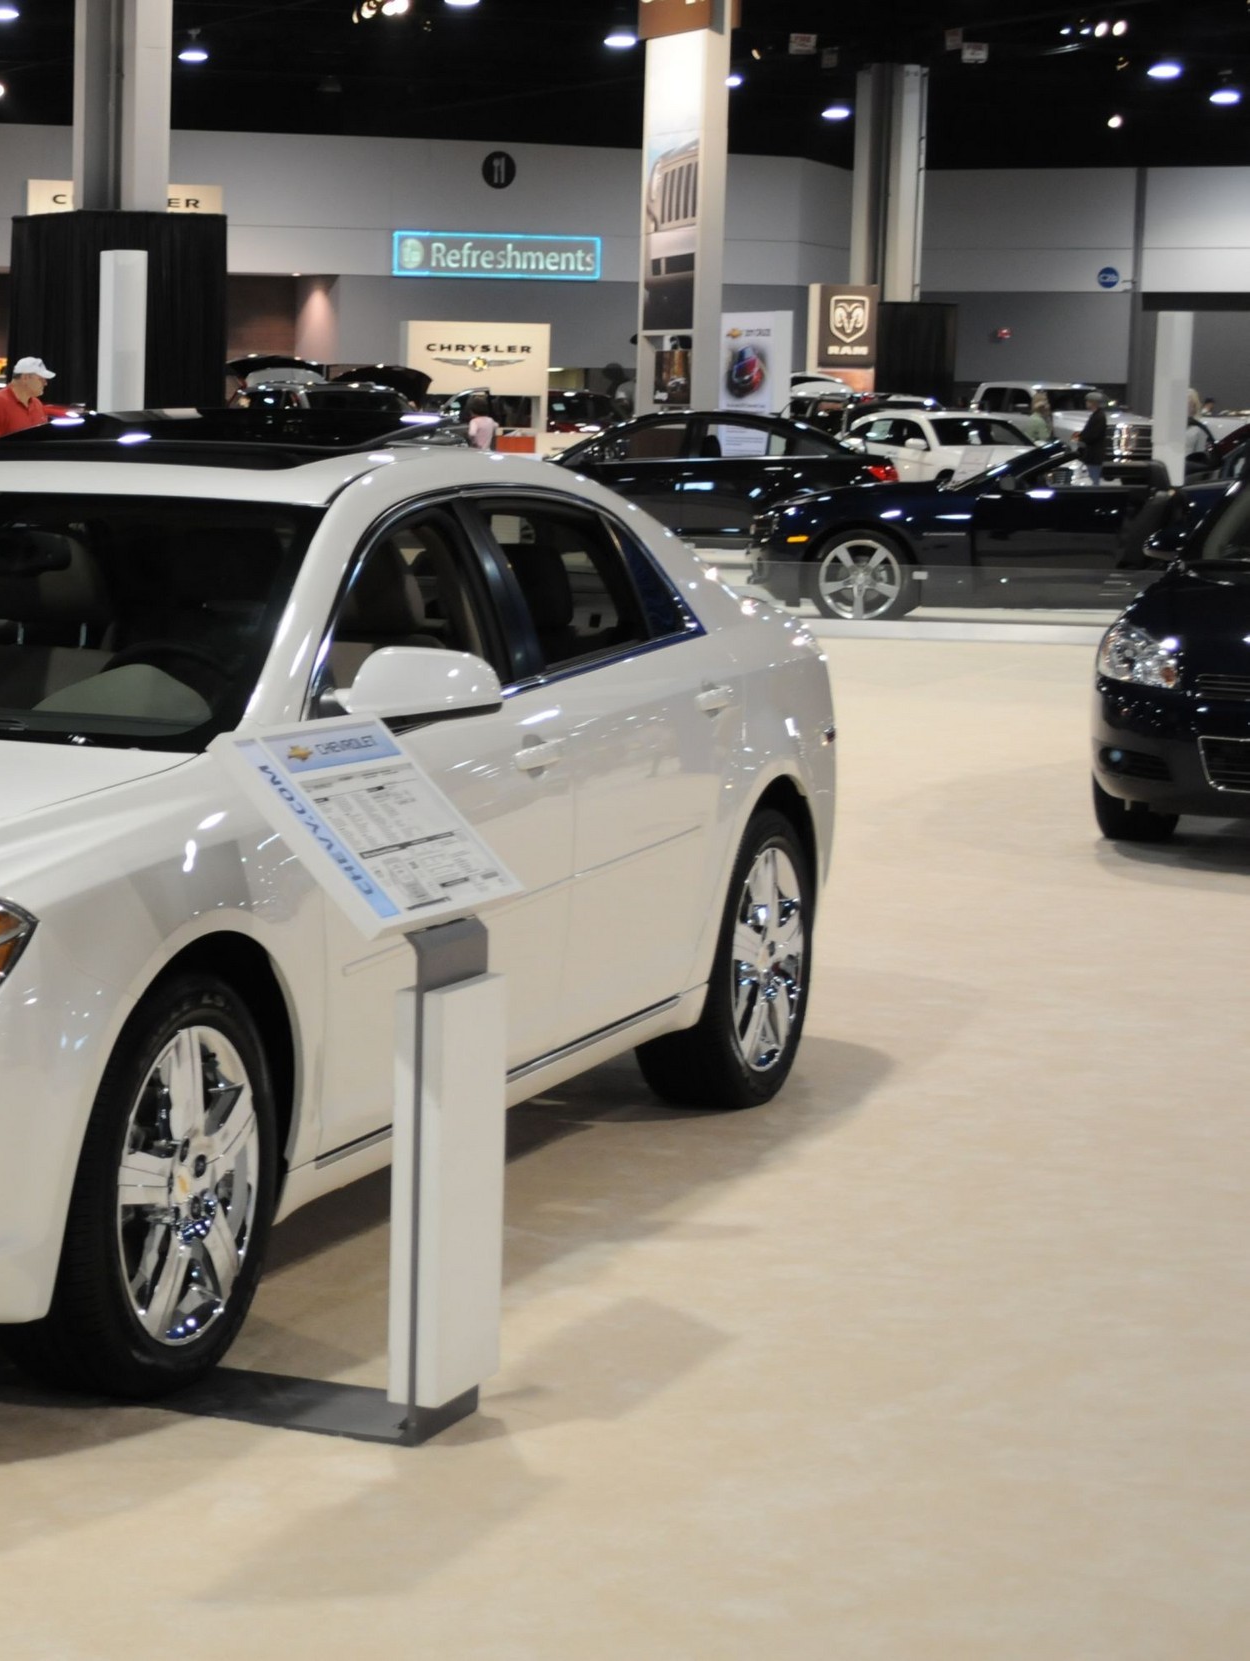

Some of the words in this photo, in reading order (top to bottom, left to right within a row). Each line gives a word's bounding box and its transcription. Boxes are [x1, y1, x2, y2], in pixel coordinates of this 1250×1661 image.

[430, 242, 596, 272] Refreshments
[426, 343, 532, 353] CHRYSLER
[827, 345, 868, 355] RAM
[315, 735, 378, 755] CHEVROLET
